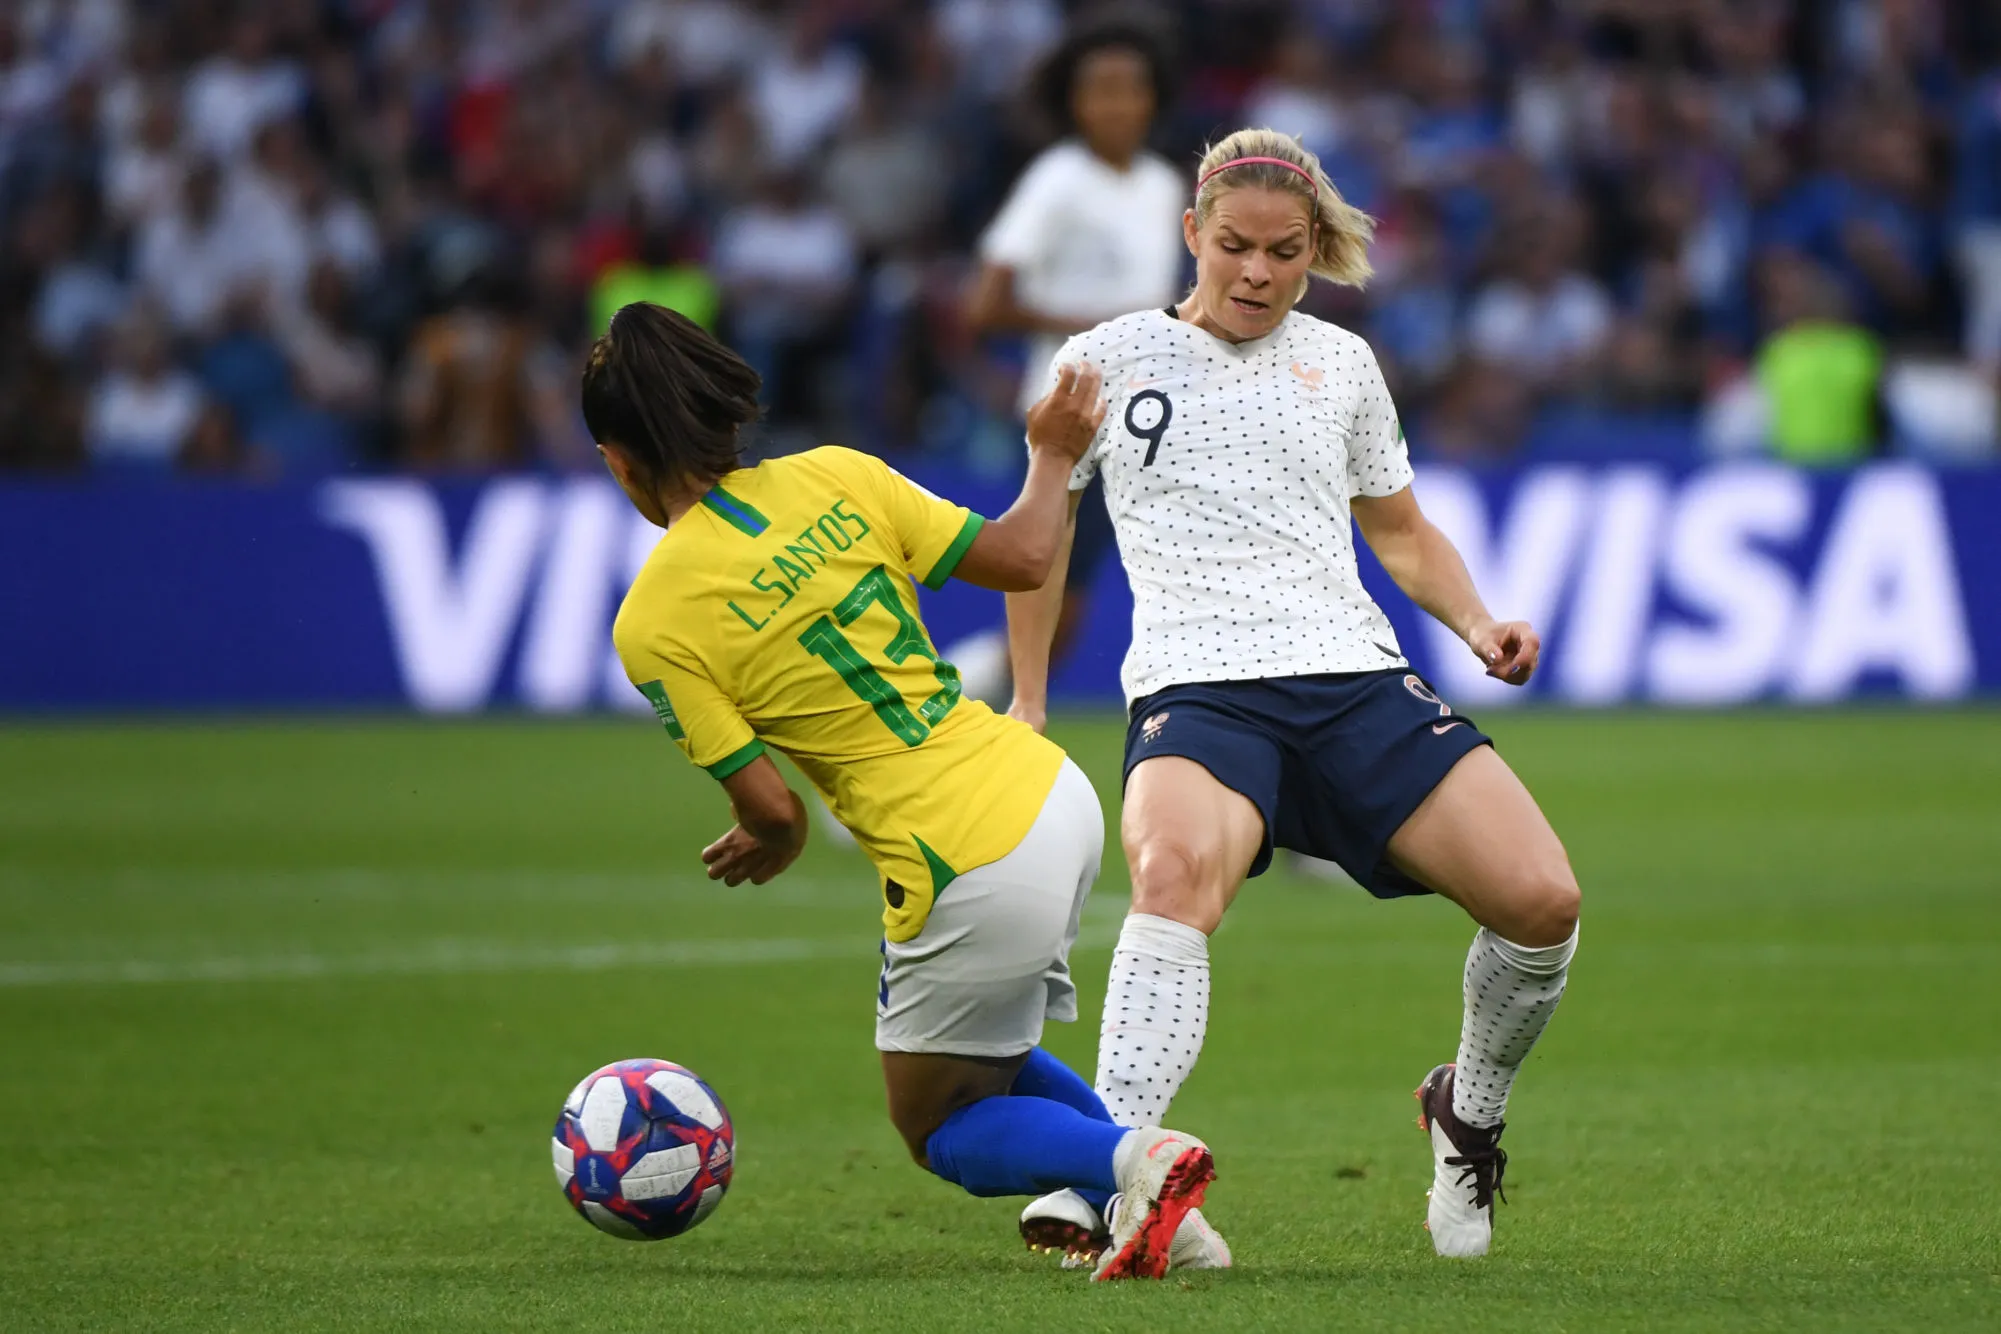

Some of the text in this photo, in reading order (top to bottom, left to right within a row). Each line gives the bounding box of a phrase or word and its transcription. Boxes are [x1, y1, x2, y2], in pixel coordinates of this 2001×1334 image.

[1124, 389, 1173, 467] 9
[320, 474, 666, 712] VI
[728, 499, 870, 632] L.SANTOS
[797, 563, 961, 747] 13
[1410, 468, 1976, 707] VISA
